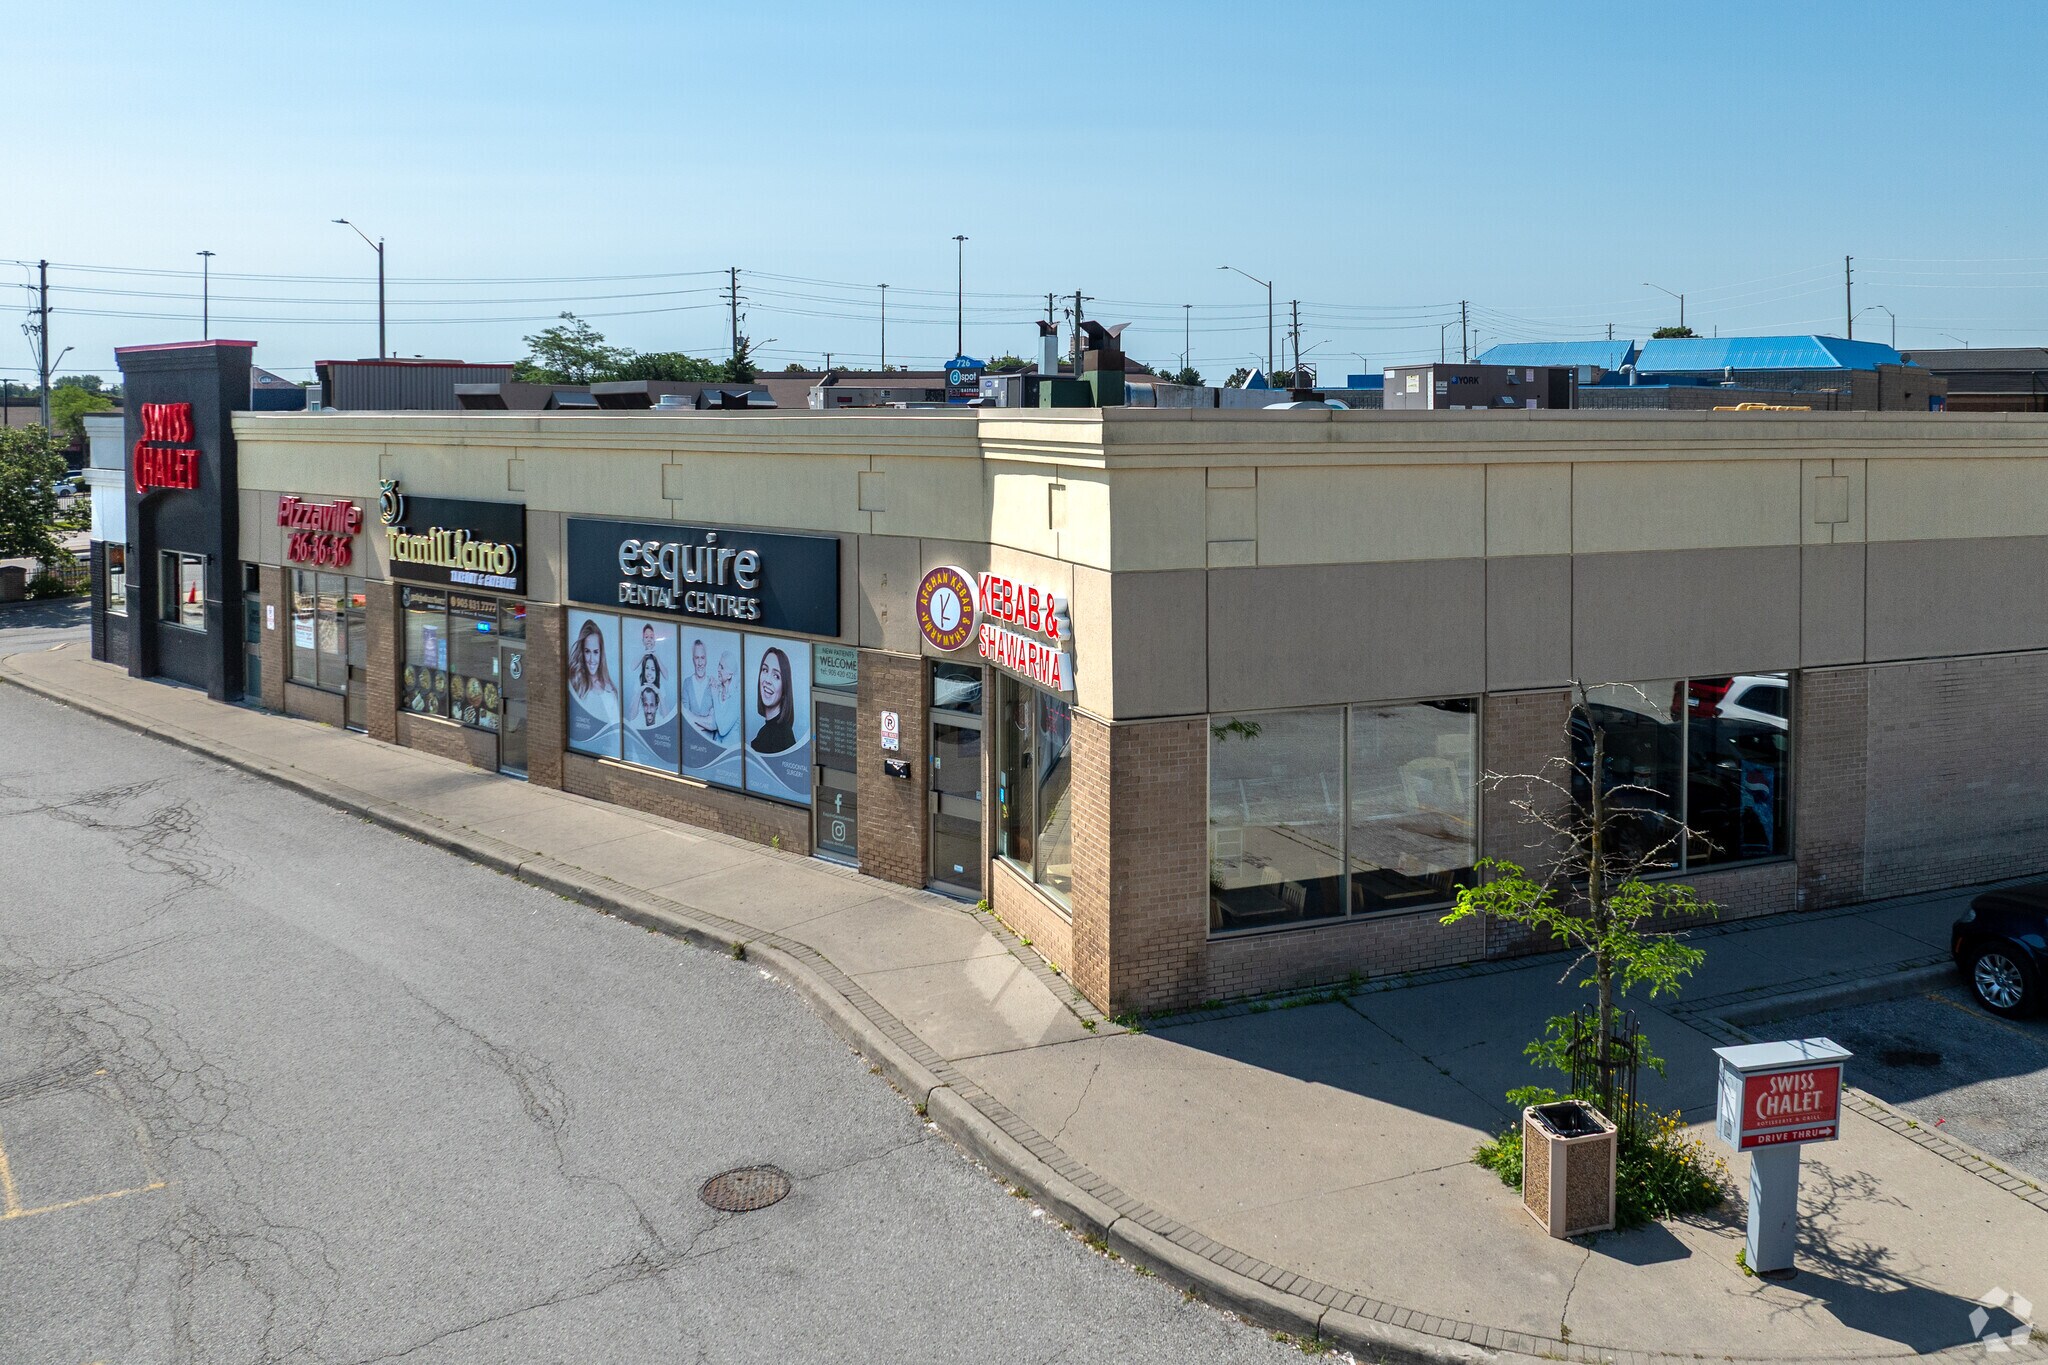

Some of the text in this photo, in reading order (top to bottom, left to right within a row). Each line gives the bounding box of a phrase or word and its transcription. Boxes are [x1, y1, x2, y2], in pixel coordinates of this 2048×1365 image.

[956, 359, 971, 367] 726
[961, 371, 977, 383] spot
[1458, 376, 1480, 384] YORK
[141, 402, 195, 442] SWISS
[134, 440, 202, 493] CHALET
[278, 495, 364, 535] Pizzaville
[618, 532, 760, 597] esquire
[618, 582, 761, 620] DENTAL CENTRES
[920, 572, 948, 605] AFGHAN
[950, 575, 971, 613] KEBAB
[977, 572, 1060, 641] KEBAB &
[921, 615, 967, 646] SHAWARMA
[820, 656, 858, 671] WELCOME
[822, 647, 855, 659] NEW PATIENTS
[978, 623, 1063, 692] SHAWARMA
[1769, 1072, 1816, 1095] SWISS
[1755, 1090, 1824, 1120] CHALET
[1757, 1117, 1792, 1127] ROTISSERIE
[1758, 1129, 1819, 1144] DRIVE THRU
